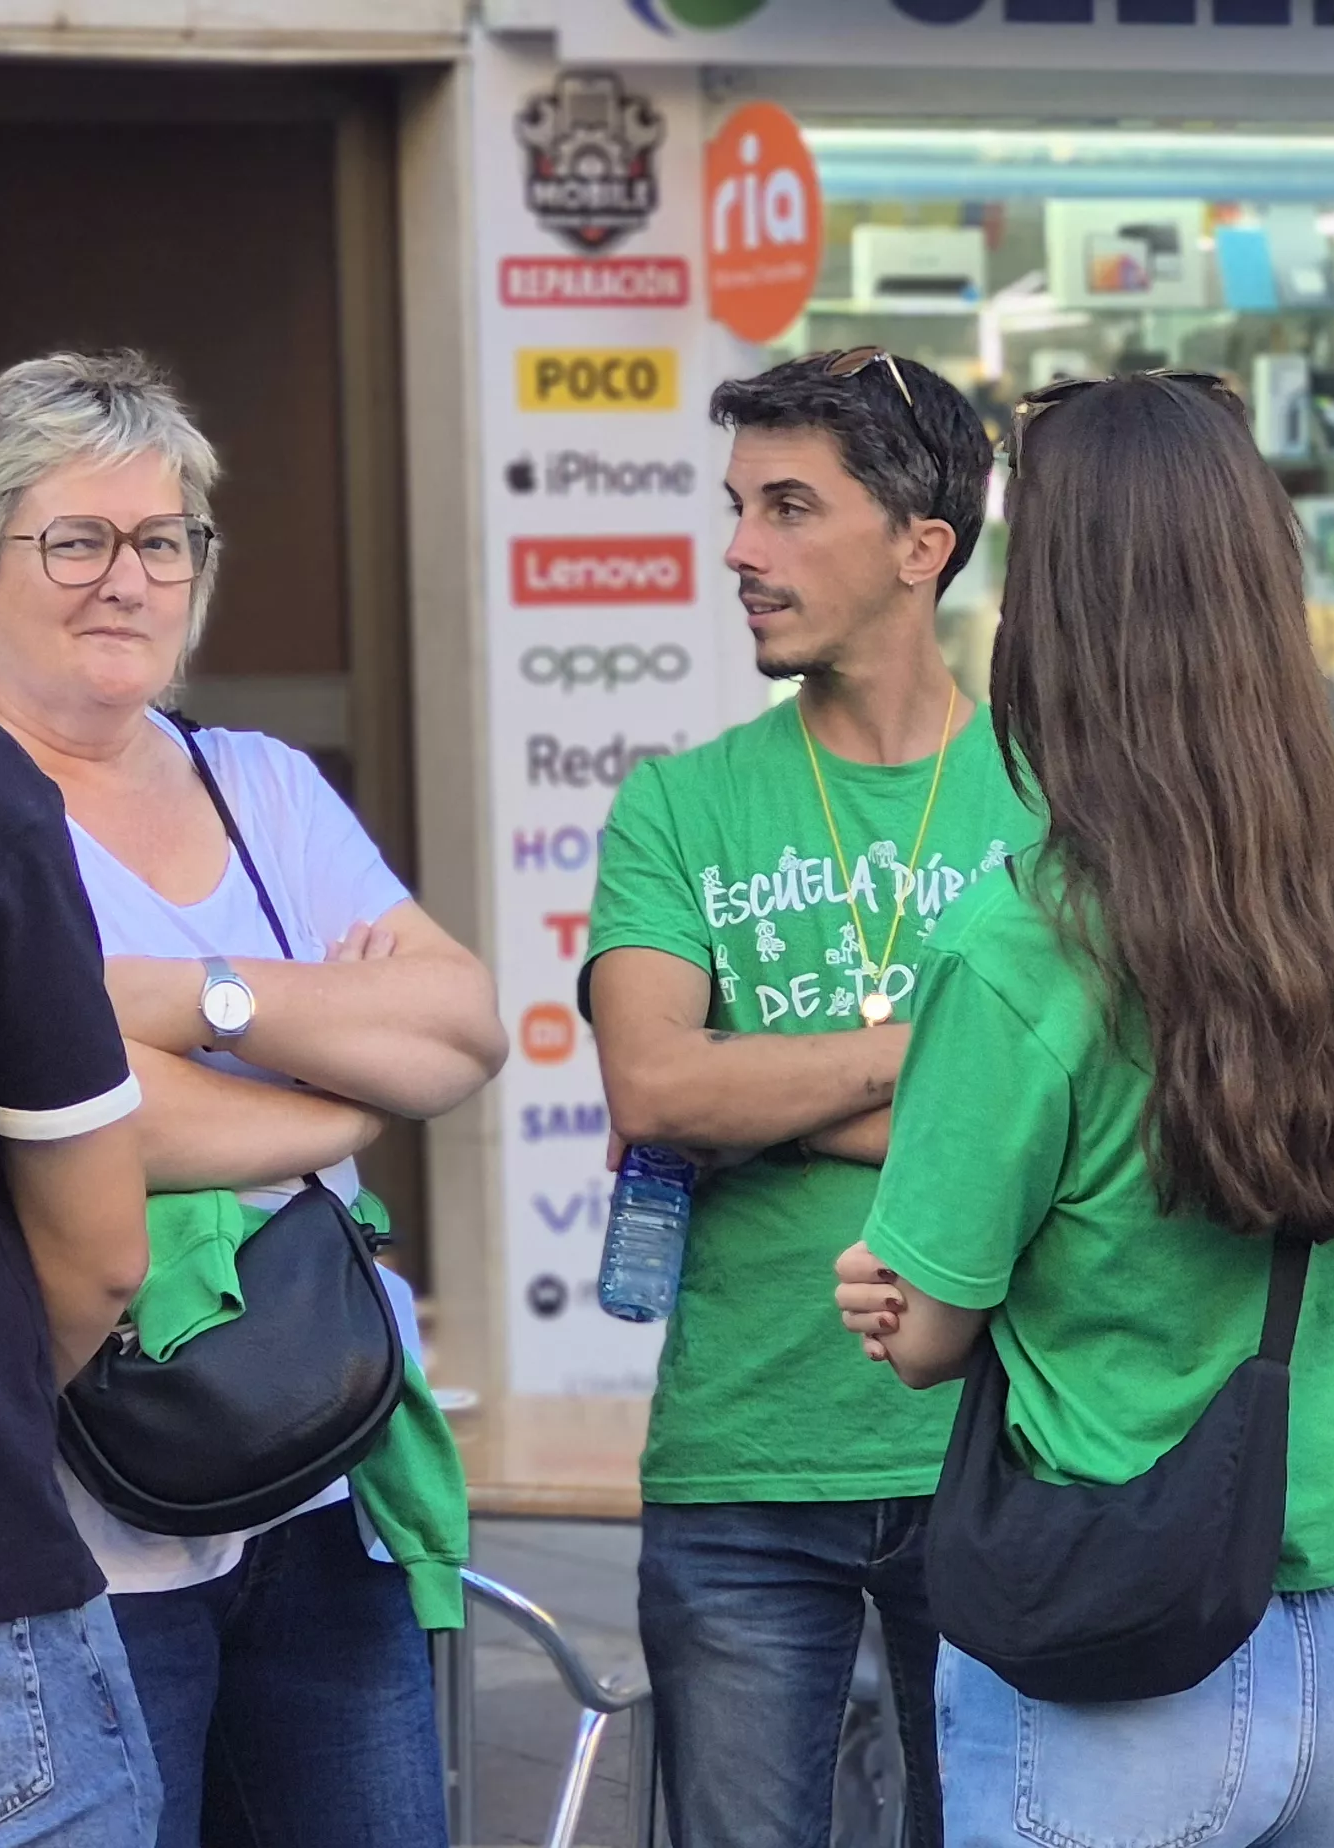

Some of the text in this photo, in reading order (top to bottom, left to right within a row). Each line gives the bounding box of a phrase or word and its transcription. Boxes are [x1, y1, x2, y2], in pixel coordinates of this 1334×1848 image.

[533, 179, 649, 208] MOBILE
[713, 133, 808, 254] ria
[509, 259, 680, 299] REPARACIÓN
[535, 357, 659, 401] POCO
[545, 449, 696, 497] iPhone
[525, 550, 680, 591] Lenovo
[519, 643, 692, 695] oppo
[704, 855, 879, 928] ESCUELA
[755, 973, 820, 1027] DE
